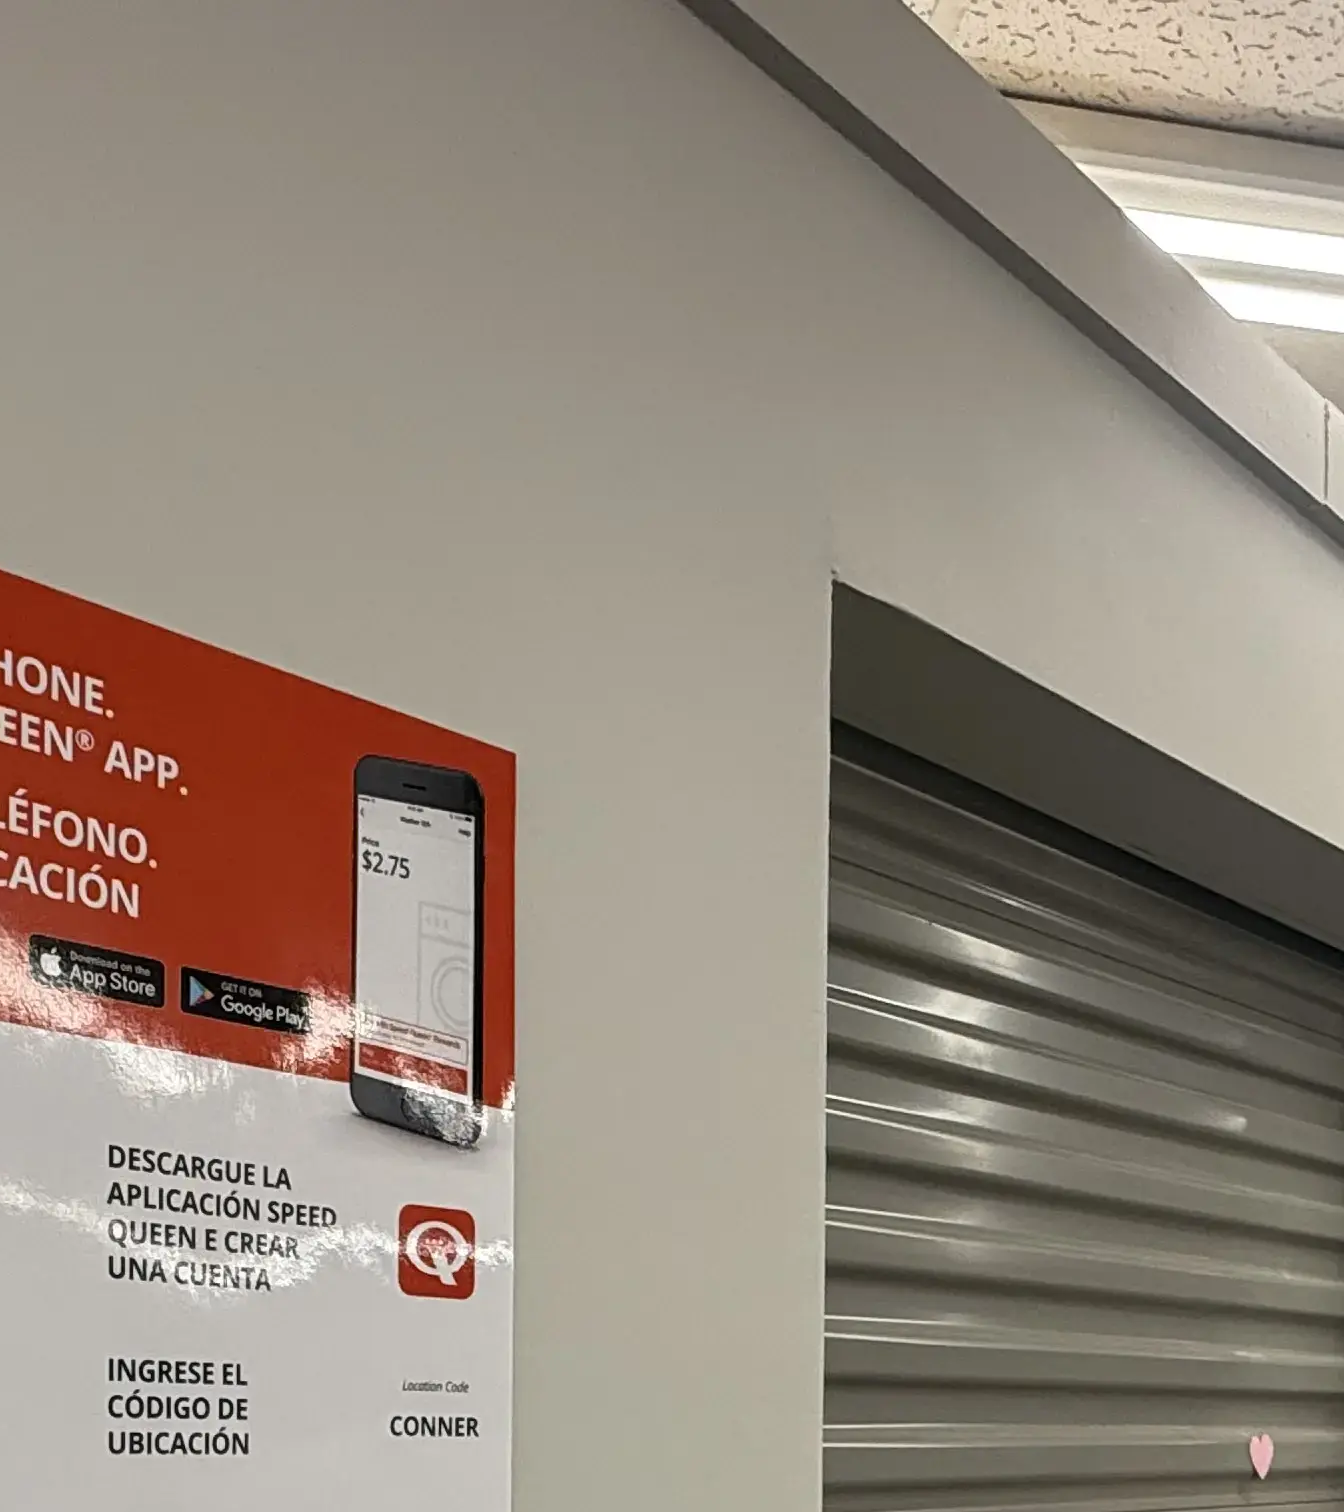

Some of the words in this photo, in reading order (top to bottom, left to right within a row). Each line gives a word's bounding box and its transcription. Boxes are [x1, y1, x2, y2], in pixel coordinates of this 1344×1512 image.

[103, 740, 188, 796] APP.
[362, 849, 410, 879] $2.75
[70, 964, 106, 990] App
[110, 974, 155, 997] Store
[221, 996, 273, 1023] Google
[277, 1005, 306, 1031] Play
[108, 1145, 255, 1186] DESCARGUE
[263, 1165, 291, 1191] LA
[107, 1182, 260, 1221] APLICACIÓN
[267, 1202, 336, 1228] SPEED
[108, 1219, 196, 1250] QUEEN
[205, 1229, 217, 1251] E
[224, 1231, 300, 1259] CREAR
[108, 1256, 166, 1284] UNA
[174, 1262, 271, 1291] CUENTA
[108, 1358, 214, 1385] INGRESE
[222, 1363, 248, 1386] EL
[402, 1380, 442, 1393] Location
[445, 1381, 469, 1394] Code
[108, 1391, 210, 1420] CÓDIGO
[218, 1398, 248, 1421] DE
[108, 1428, 249, 1455] UBICACIÓN
[390, 1415, 479, 1438] CONNER
